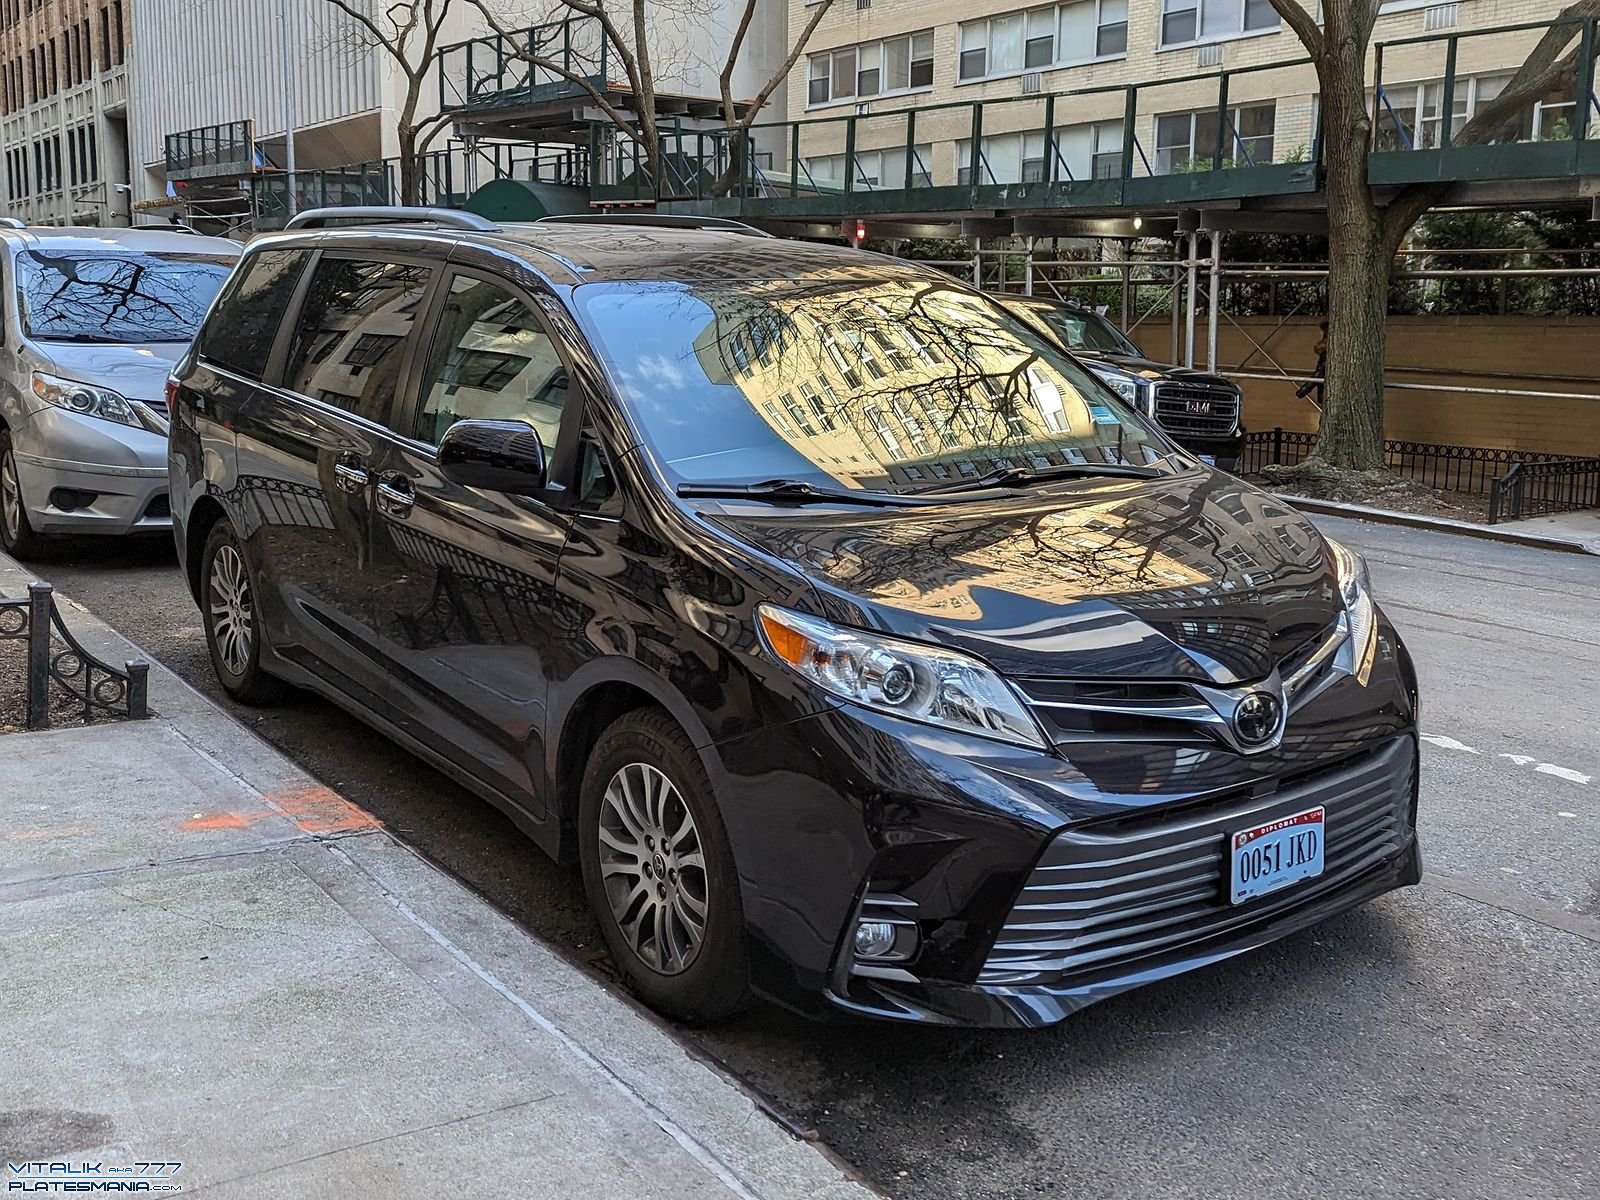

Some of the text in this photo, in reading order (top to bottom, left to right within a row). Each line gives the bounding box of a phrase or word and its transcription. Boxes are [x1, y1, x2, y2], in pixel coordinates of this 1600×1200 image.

[1261, 818, 1298, 834] DIPLOMAT
[1240, 829, 1317, 884] 0051 JKD
